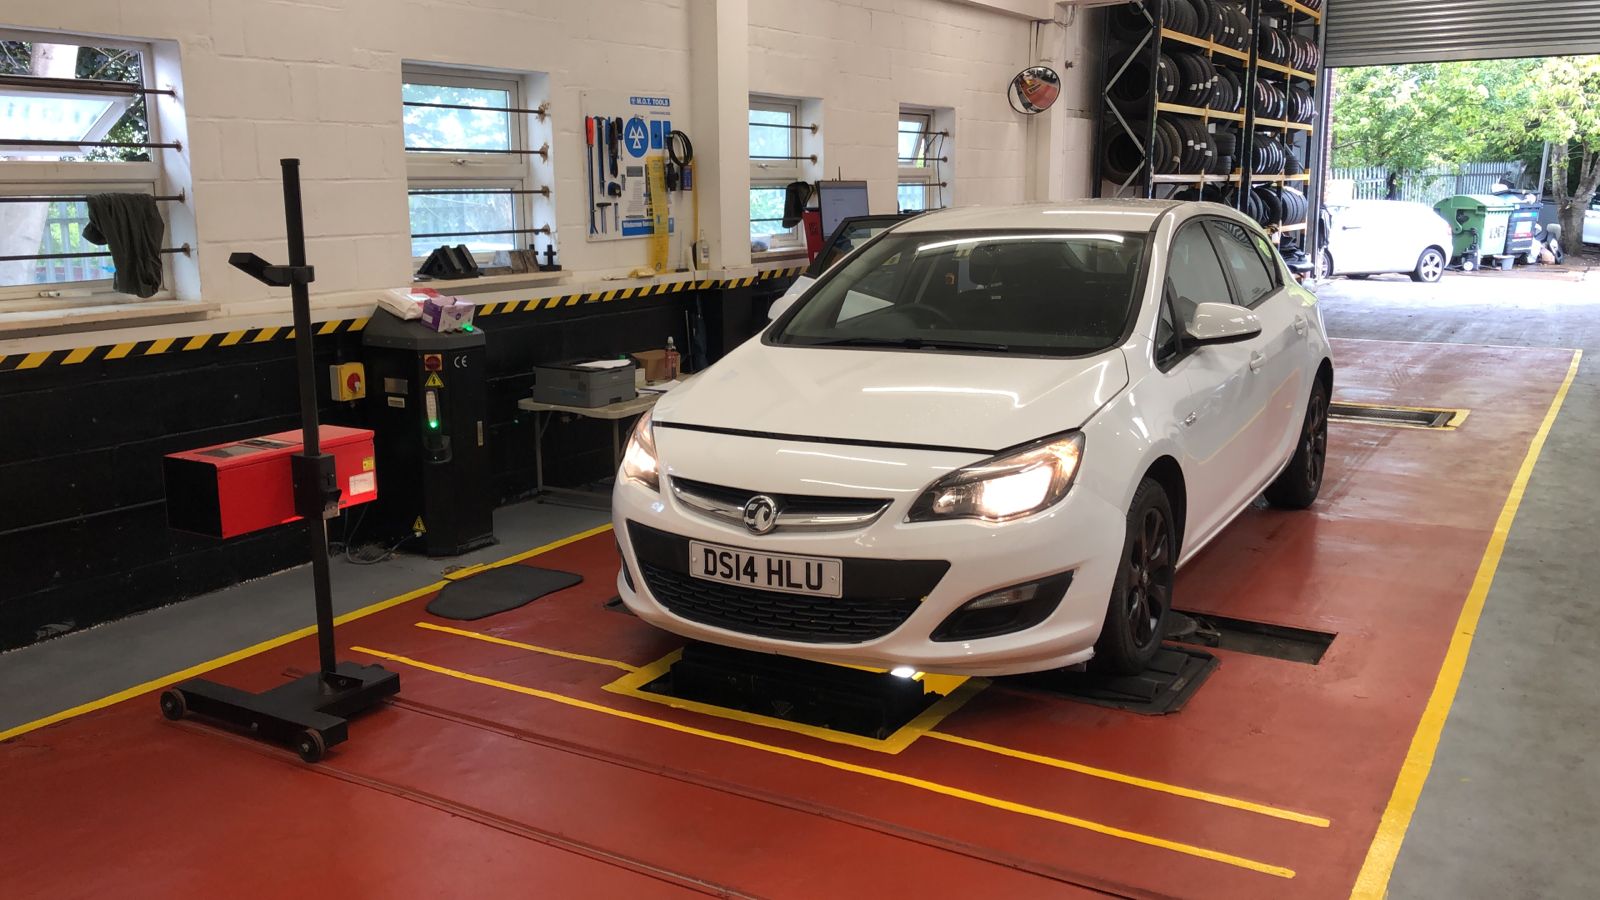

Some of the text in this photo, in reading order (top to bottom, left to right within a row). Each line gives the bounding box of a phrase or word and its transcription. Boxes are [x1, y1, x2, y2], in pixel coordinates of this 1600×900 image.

[652, 98, 669, 106] TOOLS
[454, 355, 468, 368] CE
[703, 548, 823, 590] DS14 HLU
